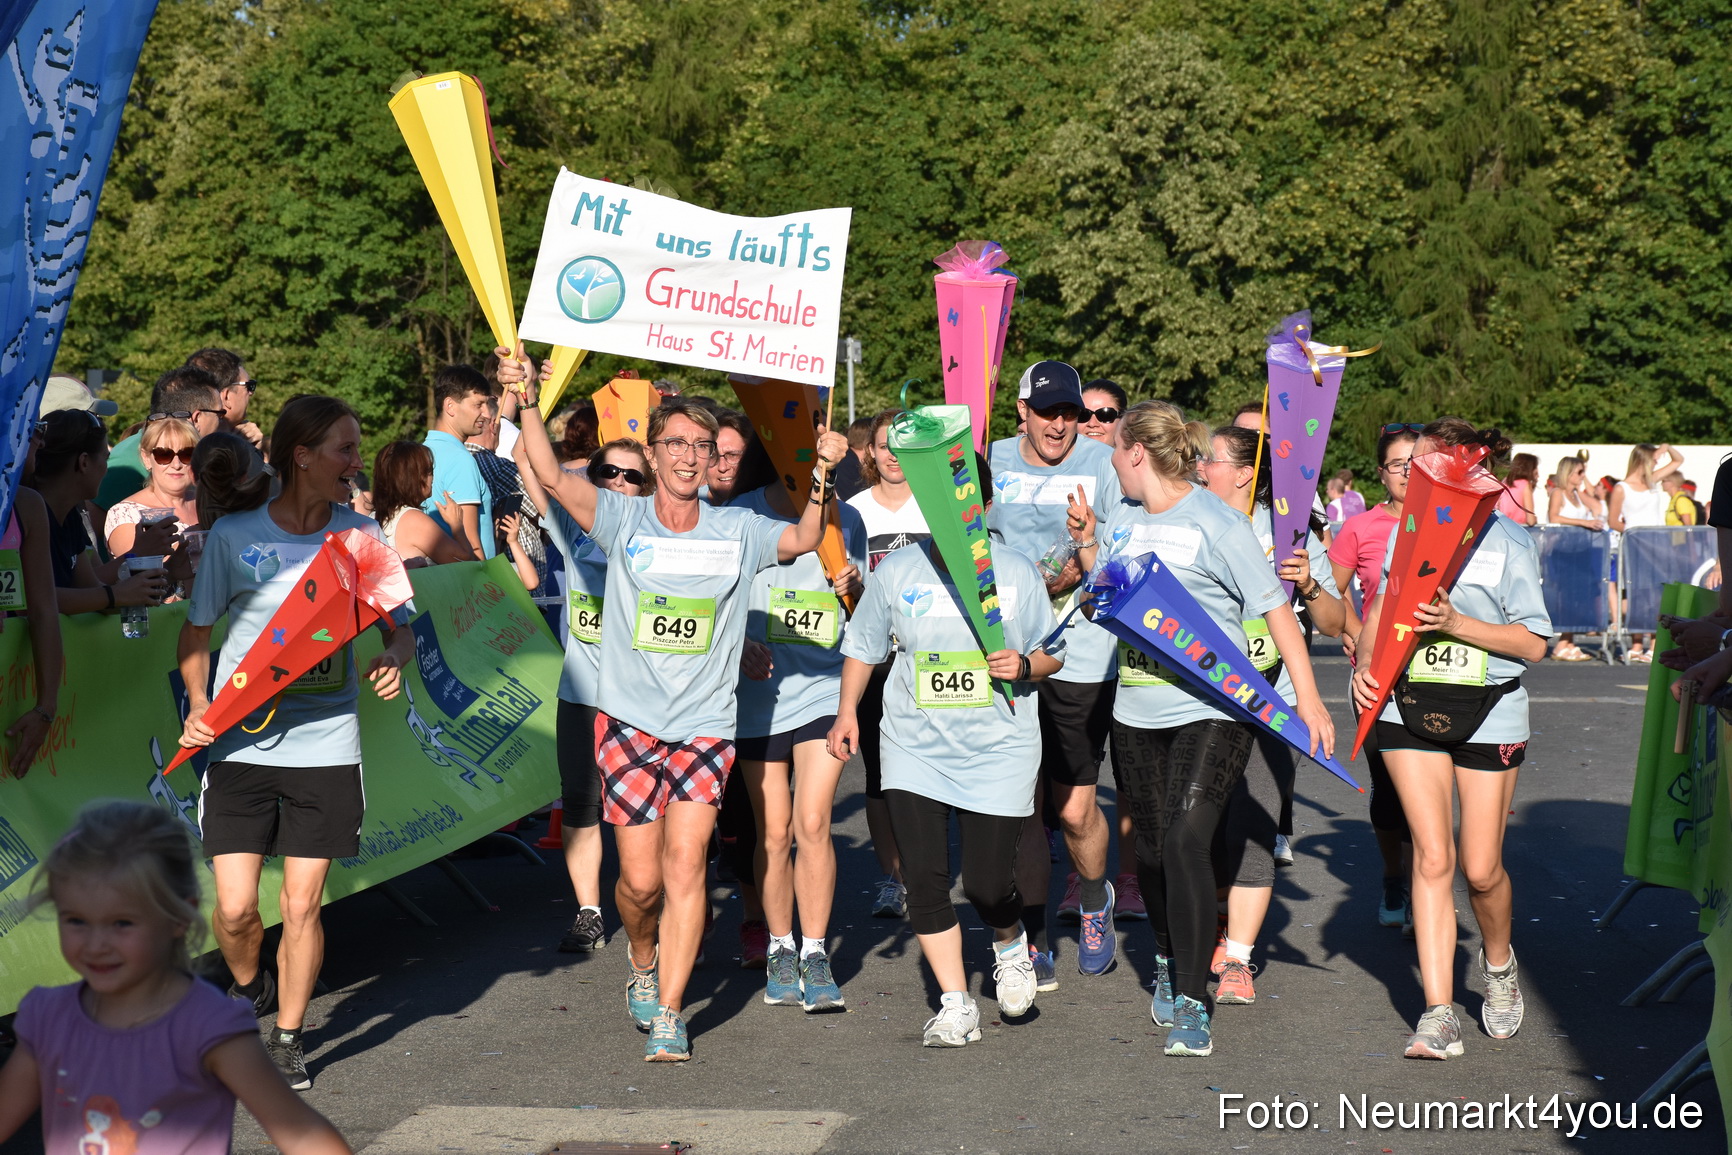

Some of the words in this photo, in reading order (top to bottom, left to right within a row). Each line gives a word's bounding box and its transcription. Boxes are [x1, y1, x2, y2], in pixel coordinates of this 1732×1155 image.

[571, 192, 631, 236] Mit
[656, 230, 711, 258] uns
[729, 223, 831, 271] läufts
[645, 267, 817, 328] Grundschule
[647, 323, 693, 352] Haus
[708, 330, 736, 361] St.
[742, 334, 824, 374] Marien
[784, 401, 799, 418] E
[1278, 392, 1290, 411] F
[1305, 418, 1319, 437] P
[1276, 440, 1293, 459] S
[947, 443, 976, 500] HAUS
[962, 504, 983, 536] ST.
[1406, 514, 1416, 532] A
[1436, 506, 1452, 525] K
[1292, 529, 1305, 546] Y
[970, 539, 1003, 627] MARIEN
[578, 610, 601, 630] 64
[653, 615, 697, 639] 649
[784, 609, 823, 630] 647
[272, 628, 286, 646] X
[652, 636, 678, 644] Piszczor
[1394, 623, 1412, 642] T
[421, 648, 440, 672] Fischer
[1425, 646, 1468, 668] 648
[270, 665, 289, 682] T
[1143, 608, 1290, 732] GRUNDSCHULE
[232, 672, 247, 689] D
[931, 672, 974, 692] 646
[438, 667, 541, 764] firmenlauf
[1424, 712, 1451, 724] CAMEL
[494, 735, 531, 774] neumarkt
